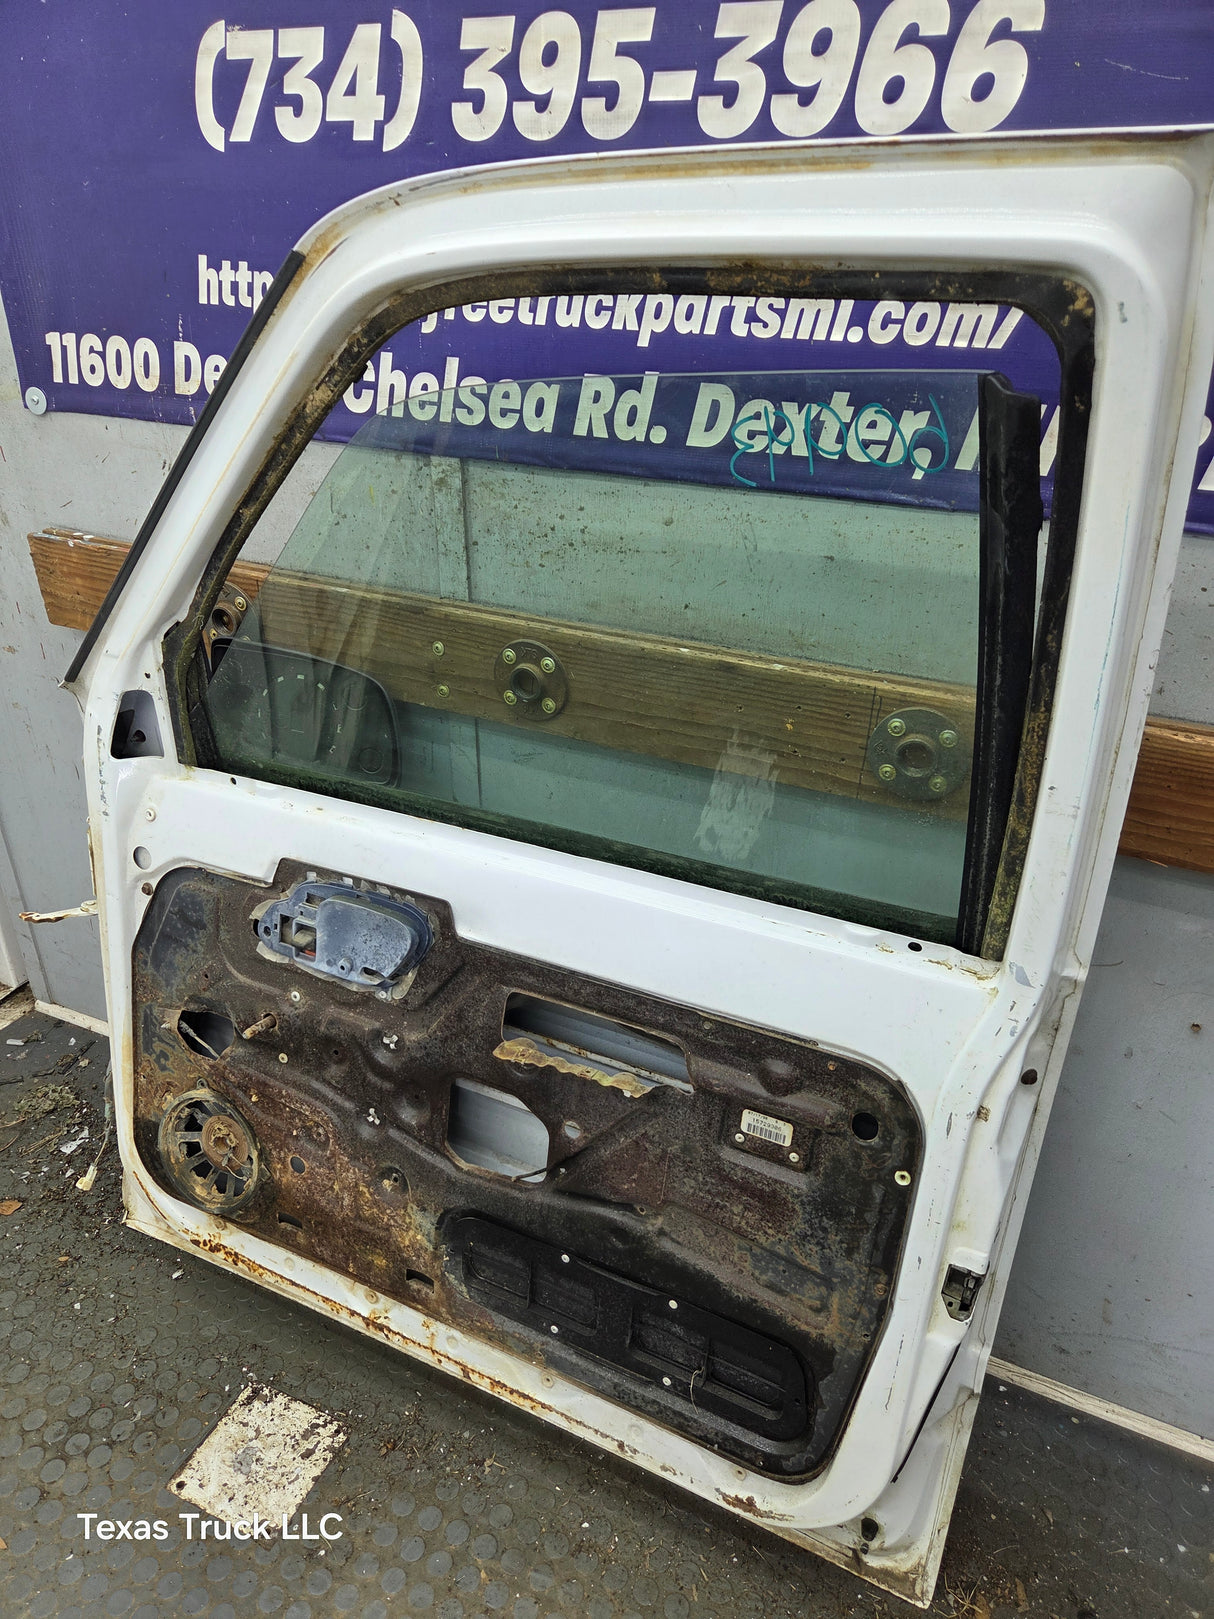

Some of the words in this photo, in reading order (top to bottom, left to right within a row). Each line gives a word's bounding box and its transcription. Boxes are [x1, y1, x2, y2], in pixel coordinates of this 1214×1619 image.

[194, 9, 423, 152] (734)
[451, 0, 1046, 142] 395-3966
[45, 331, 160, 393] 11600
[342, 352, 560, 433] Chelsea
[572, 371, 667, 444] Rd.
[686, 382, 932, 480] Dexter,
